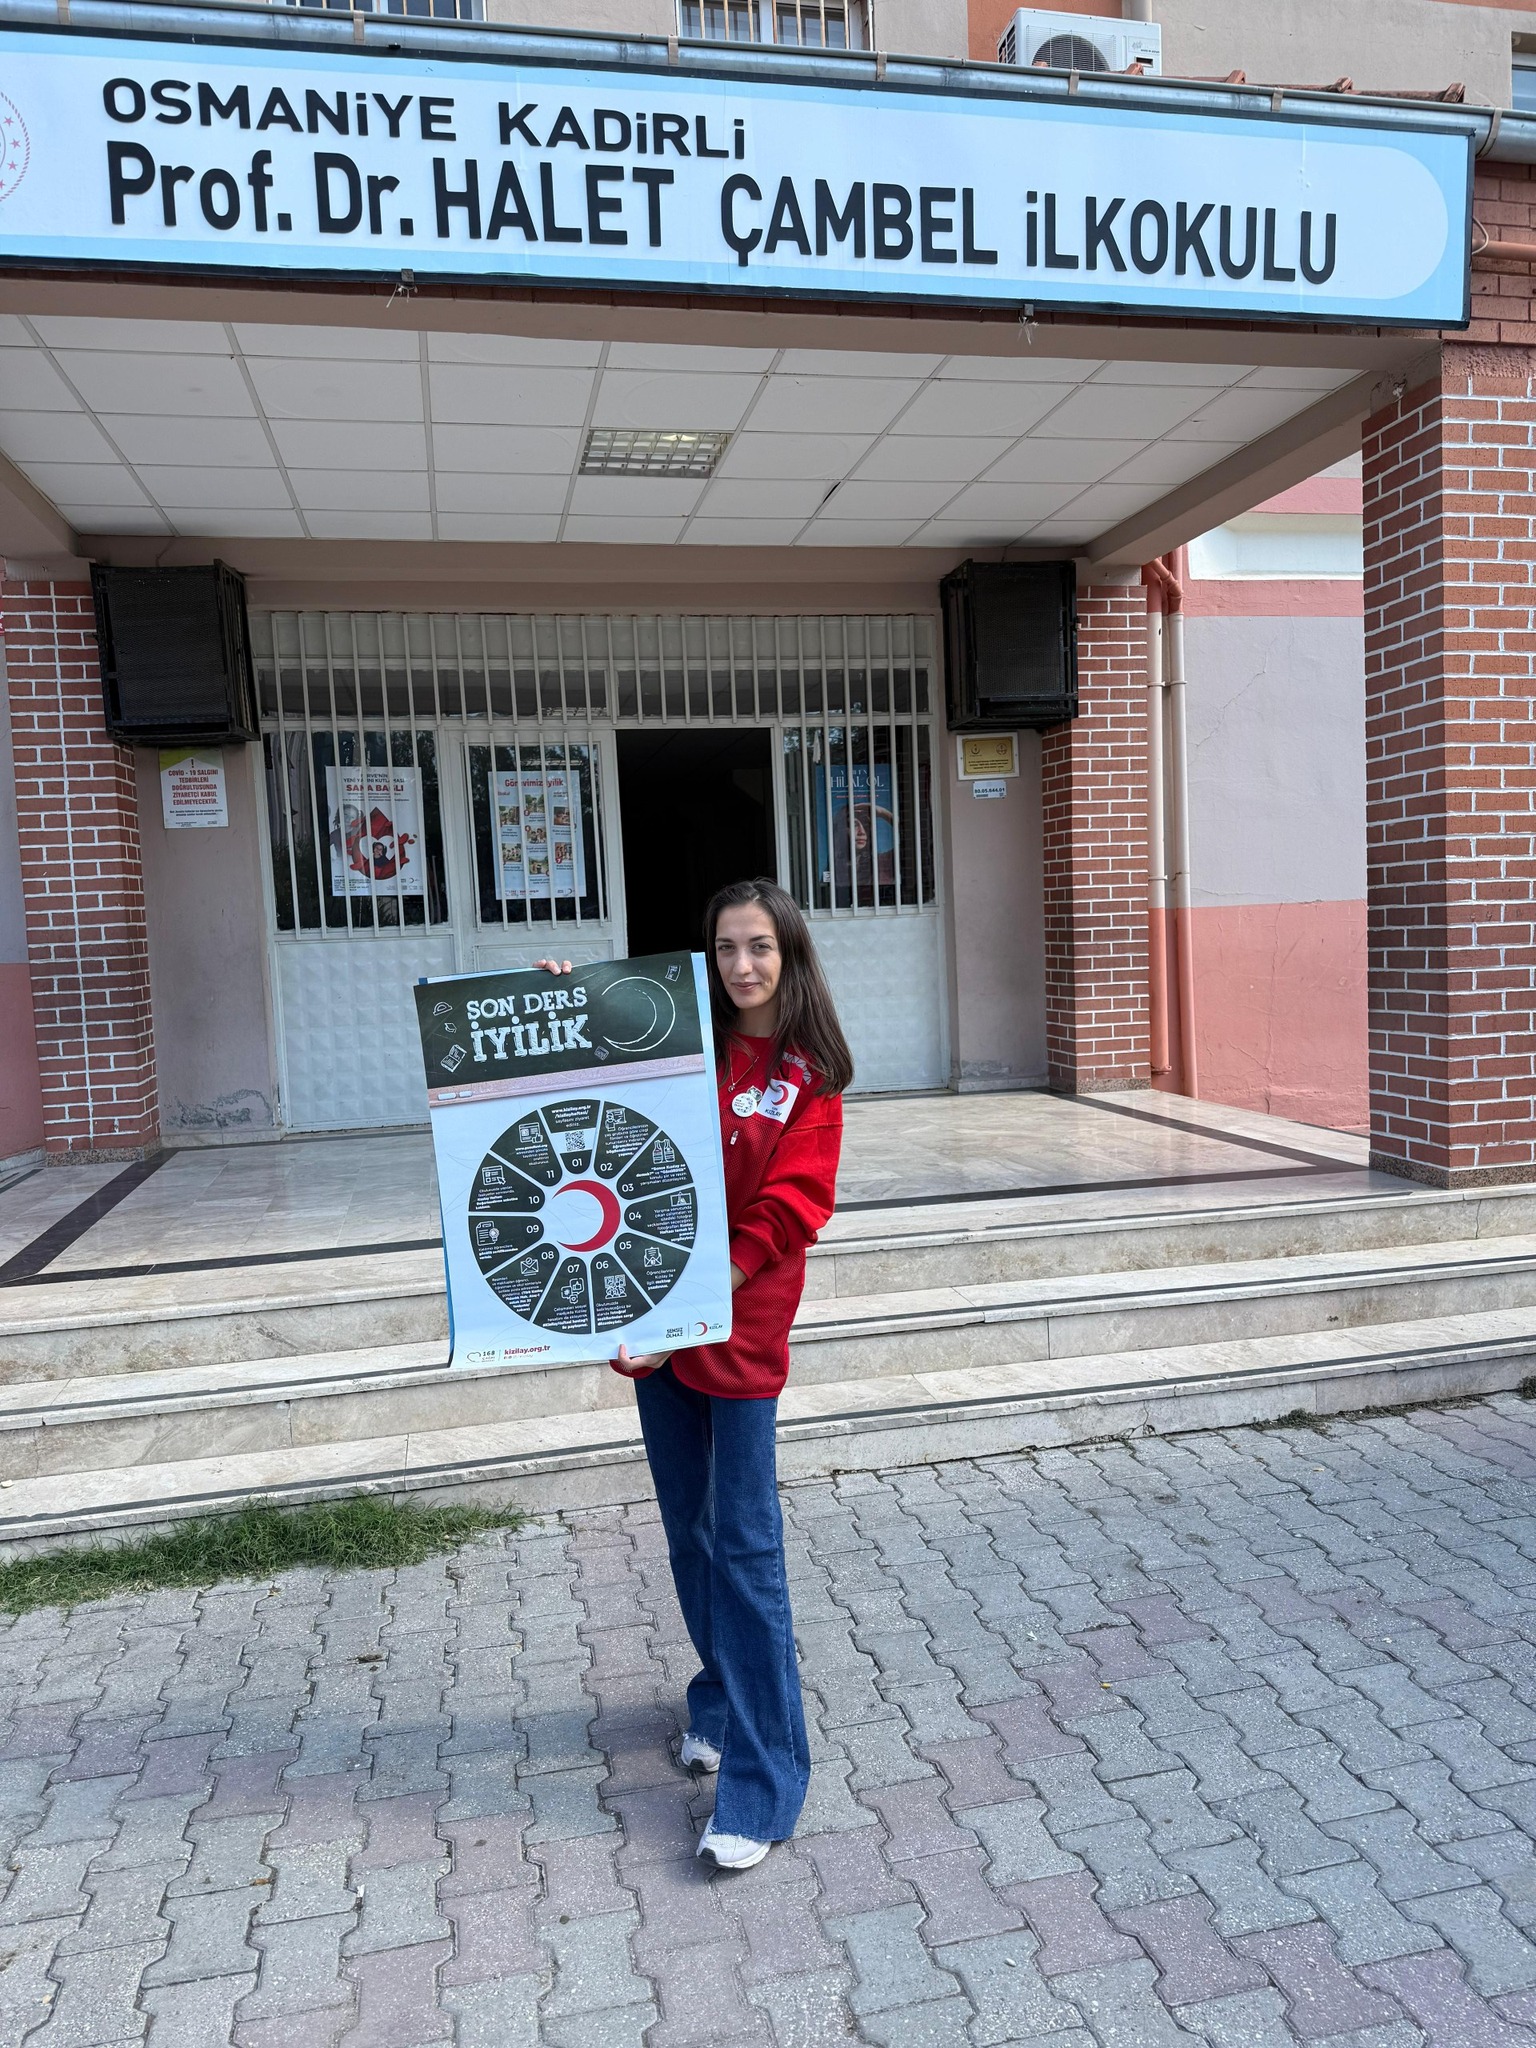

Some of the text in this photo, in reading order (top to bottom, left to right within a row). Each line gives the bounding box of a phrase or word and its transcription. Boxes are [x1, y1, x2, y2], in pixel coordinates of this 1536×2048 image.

[107, 140, 292, 232] Prof.
[314, 152, 414, 236] Dr.
[433, 157, 674, 246] HALET
[720, 174, 998, 266] ÇAMBEL
[466, 987, 588, 1020] SON DERS
[471, 1011, 592, 1062] İYİLİK
[572, 1159, 582, 1167] 01
[600, 1163, 613, 1171] 02
[622, 1184, 634, 1192] 03
[529, 1196, 539, 1204] 10
[629, 1212, 641, 1220] 04
[526, 1225, 539, 1233] 09
[619, 1242, 631, 1250] 05
[541, 1251, 554, 1260] 08
[567, 1265, 580, 1273] 07
[596, 1261, 609, 1269] 06
[505, 1345, 551, 1355] kizilay.org.tr
